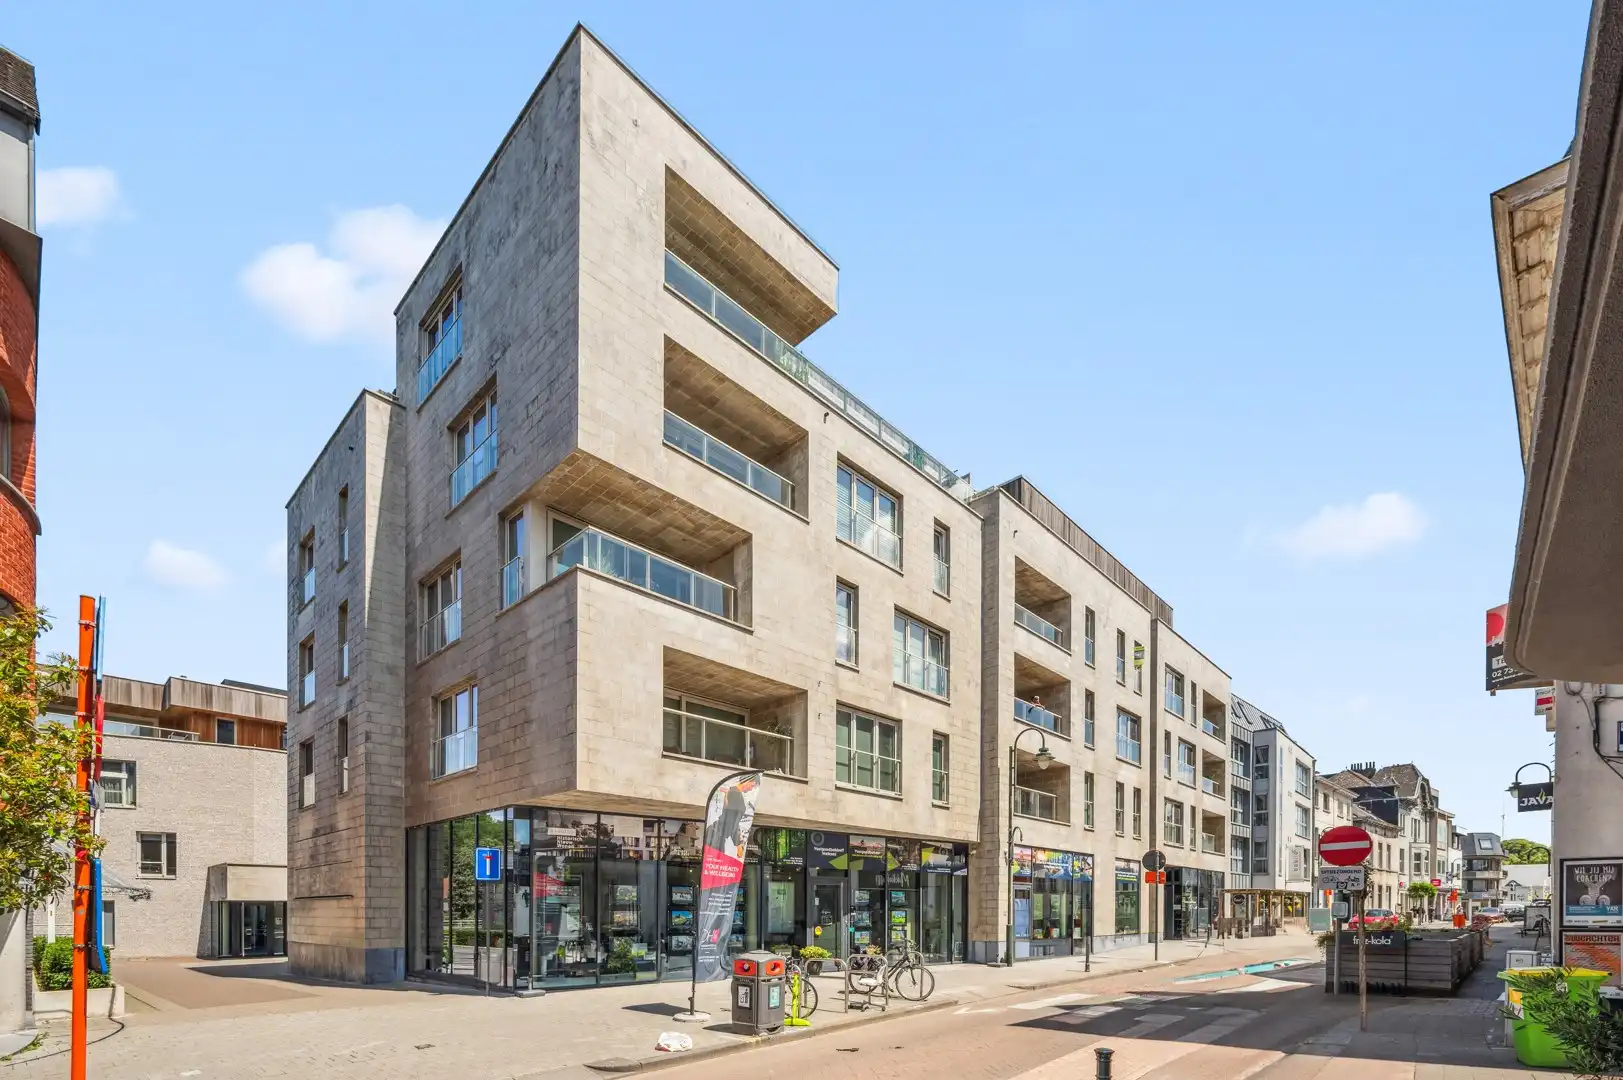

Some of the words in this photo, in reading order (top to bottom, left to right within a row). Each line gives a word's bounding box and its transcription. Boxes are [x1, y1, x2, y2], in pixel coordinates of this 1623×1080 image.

[1519, 795, 1554, 807] JAVA
[1574, 866, 1585, 874] WIL
[1590, 866, 1599, 874] JIJ
[1576, 874, 1612, 882] COACHEN?
[1352, 935, 1392, 945] frz-kola
